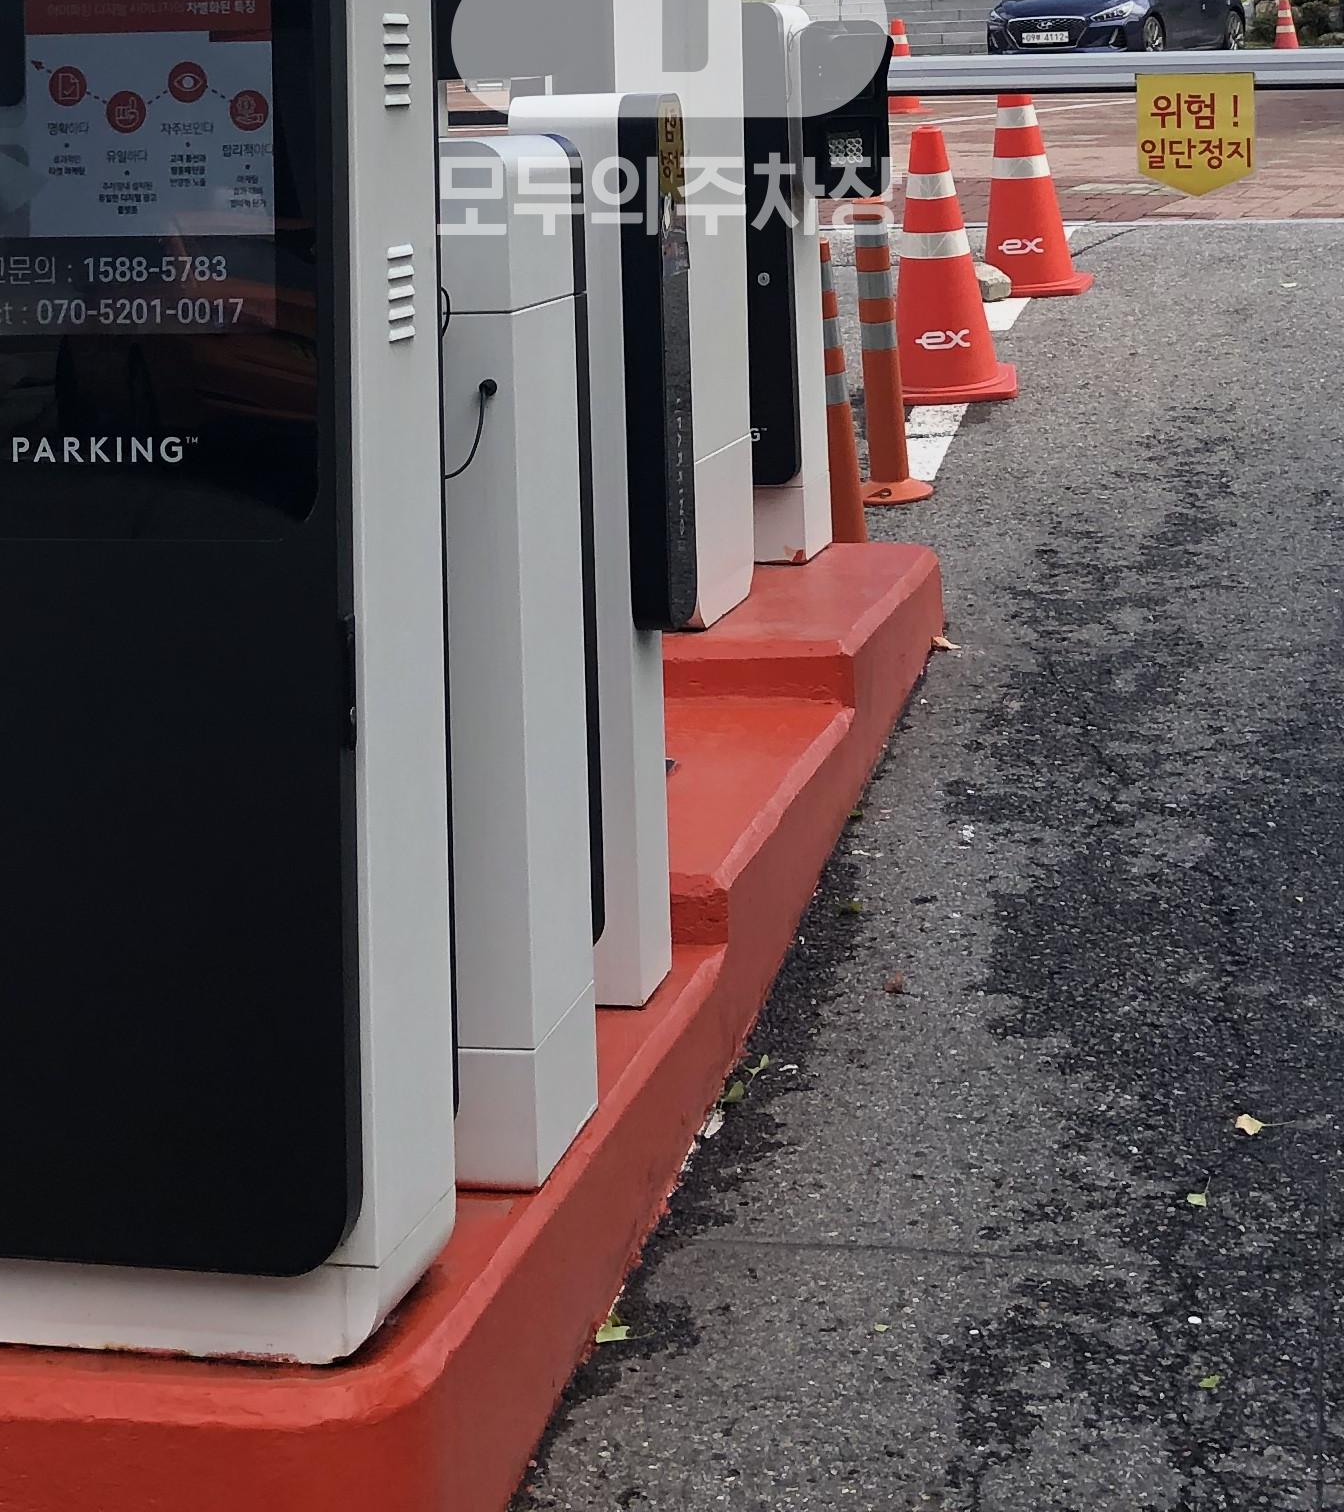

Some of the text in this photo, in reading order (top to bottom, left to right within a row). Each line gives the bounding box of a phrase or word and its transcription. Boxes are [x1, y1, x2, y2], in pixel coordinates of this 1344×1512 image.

[1141, 138, 1252, 170] 일단정지
[998, 237, 1044, 255] ex
[83, 255, 228, 284] 1588-5783
[36, 297, 244, 327] 070-5201-0017
[914, 329, 971, 350] ex
